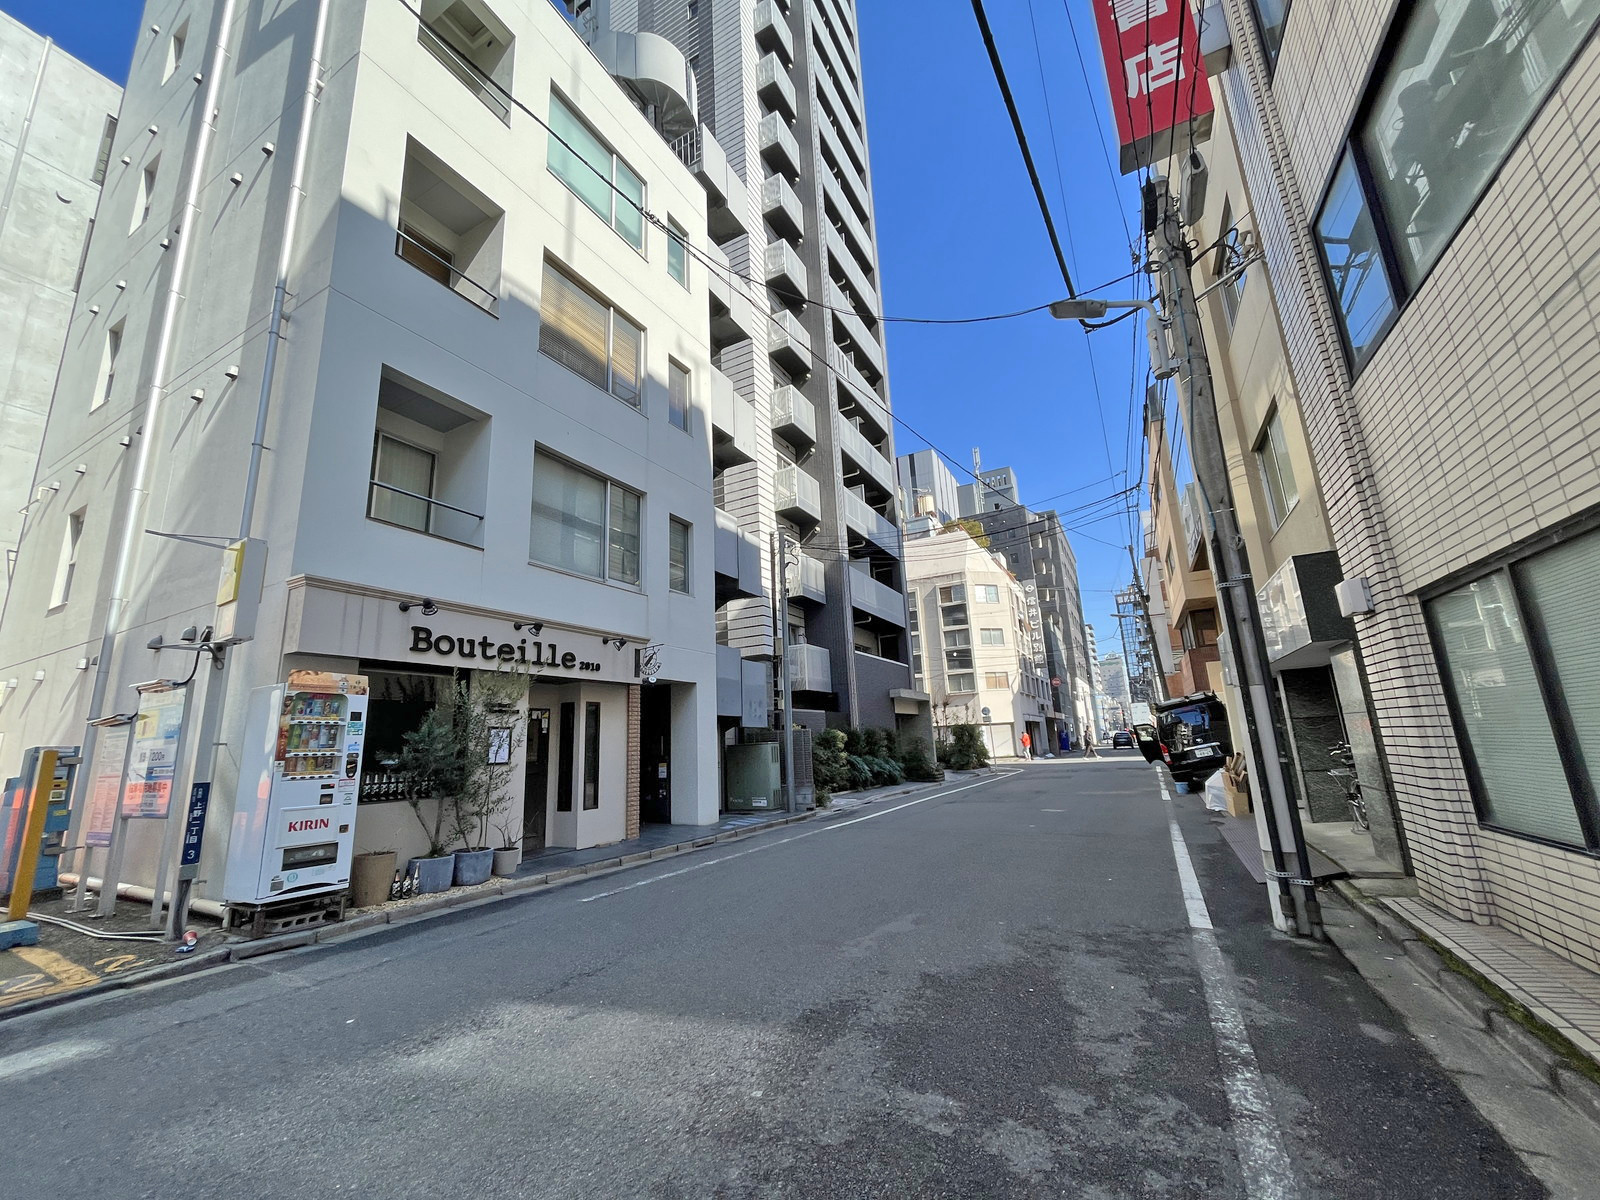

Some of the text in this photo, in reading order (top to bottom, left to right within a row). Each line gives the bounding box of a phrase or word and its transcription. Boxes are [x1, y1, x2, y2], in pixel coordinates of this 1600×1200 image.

[410, 626, 601, 672] Bouteille 2010
[189, 802, 202, 844] 上野一丁目
[288, 818, 329, 832] KIRIN
[187, 850, 195, 859] 3
